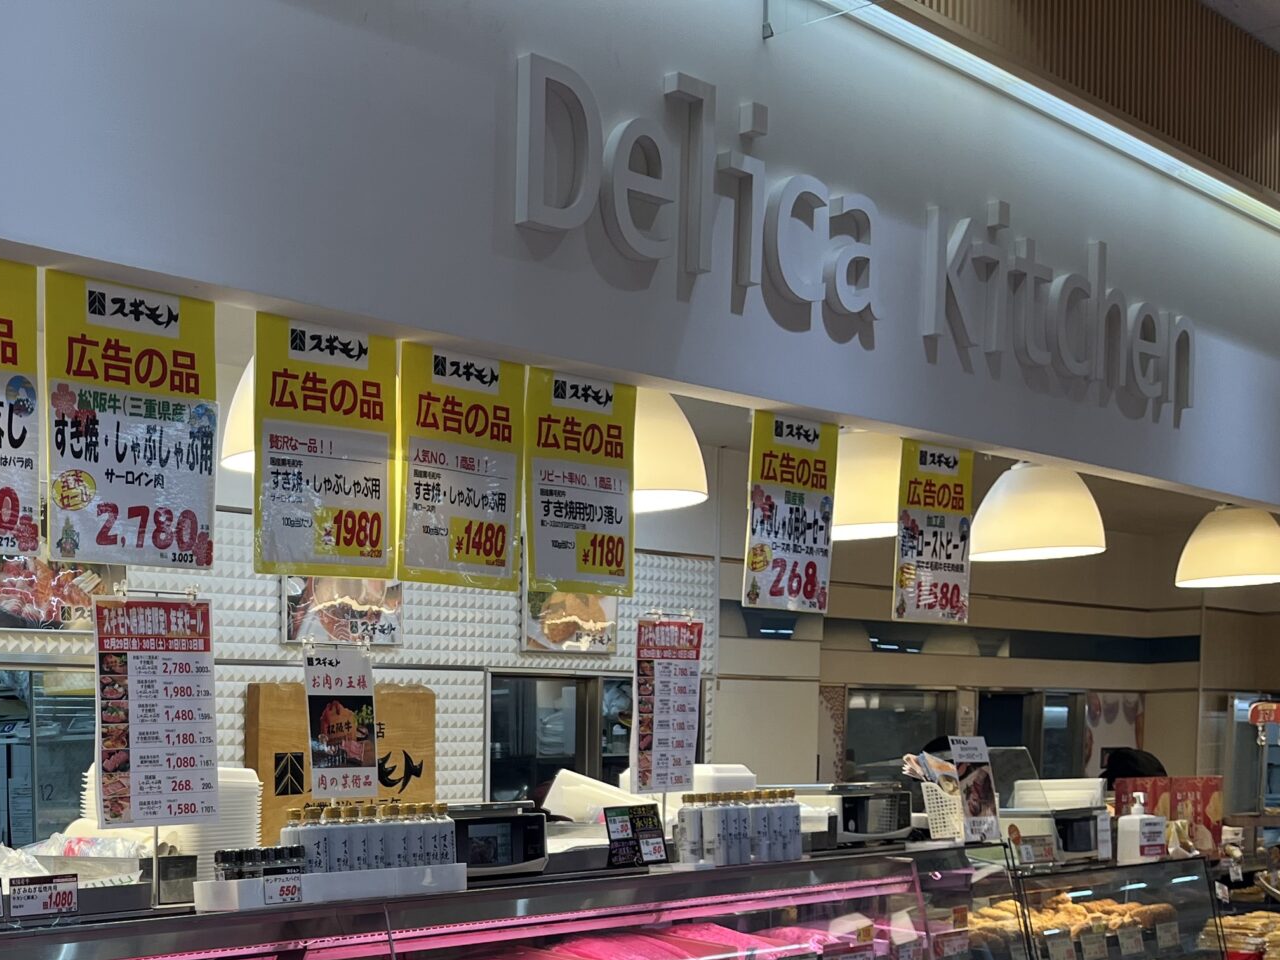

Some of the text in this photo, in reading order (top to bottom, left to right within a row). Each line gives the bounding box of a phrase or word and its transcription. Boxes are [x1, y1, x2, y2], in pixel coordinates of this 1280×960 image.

[516, 53, 1196, 412] Delica Kitchen
[110, 297, 178, 328] スギモト
[309, 334, 368, 360] スギモト
[66, 333, 199, 395] 広告の品
[449, 360, 498, 387] スギモト
[270, 368, 383, 421] 広告の品
[569, 384, 613, 408] スギモト
[416, 392, 512, 443] 広告の品
[54, 413, 213, 475] すき焼・しゃぶしゃぶ用
[537, 414, 624, 459] 広告の品
[785, 423, 819, 444] スギモト
[760, 450, 827, 490] 広告の品
[929, 452, 958, 469] スギモト
[105, 469, 164, 489] サーロイン肉
[270, 470, 381, 500] すき焼・しゃぶしゃぶ用
[413, 481, 506, 513] すき焼・しゃぶしゃぶ用
[907, 478, 964, 512] 広告の品
[541, 500, 623, 525] すき焼用切り落し
[96, 502, 198, 551] 2,780
[770, 558, 817, 600] 268
[360, 622, 396, 635] スギモト
[162, 662, 191, 674] 2,780
[163, 686, 192, 698] 1,980
[312, 674, 368, 689] お肉の王様
[164, 709, 194, 721] 1,480
[165, 733, 194, 744] 1,180
[166, 756, 196, 769] 1,080
[171, 780, 191, 792] 268
[318, 774, 372, 790] 肉の芸術品
[167, 803, 196, 815] 1,580
[47, 891, 73, 909] 1,080
[279, 885, 297, 897] 550
